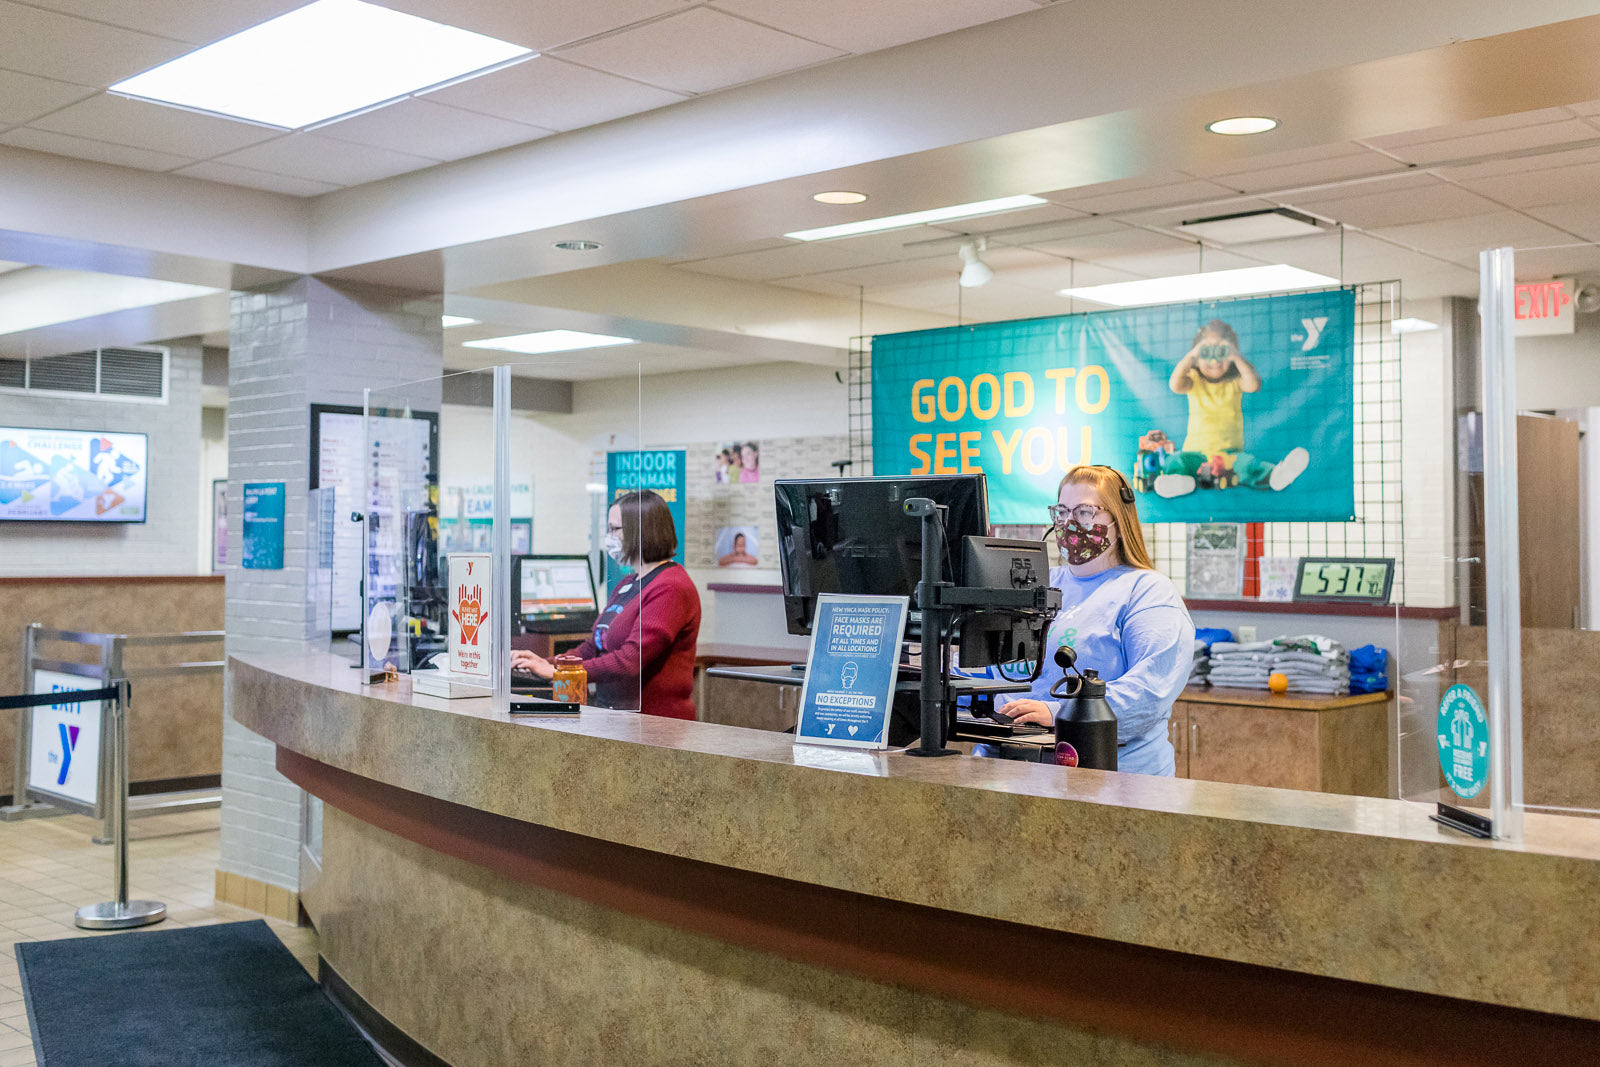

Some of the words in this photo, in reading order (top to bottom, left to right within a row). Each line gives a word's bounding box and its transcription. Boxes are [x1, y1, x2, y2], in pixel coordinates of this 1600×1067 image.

[1515, 282, 1565, 320] EXIT
[911, 371, 1035, 423] GOOD
[1045, 365, 1111, 415] TO
[909, 431, 983, 475] SEE
[991, 425, 1092, 476] YOU
[615, 452, 676, 471] INDOOR
[462, 614, 477, 626] HERE
[832, 624, 881, 637] REQUIRED
[473, 651, 481, 660] this
[461, 660, 478, 669] together
[817, 695, 829, 703] NO
[830, 696, 874, 706] EXCEPTIONS
[1453, 763, 1474, 782] FREE
